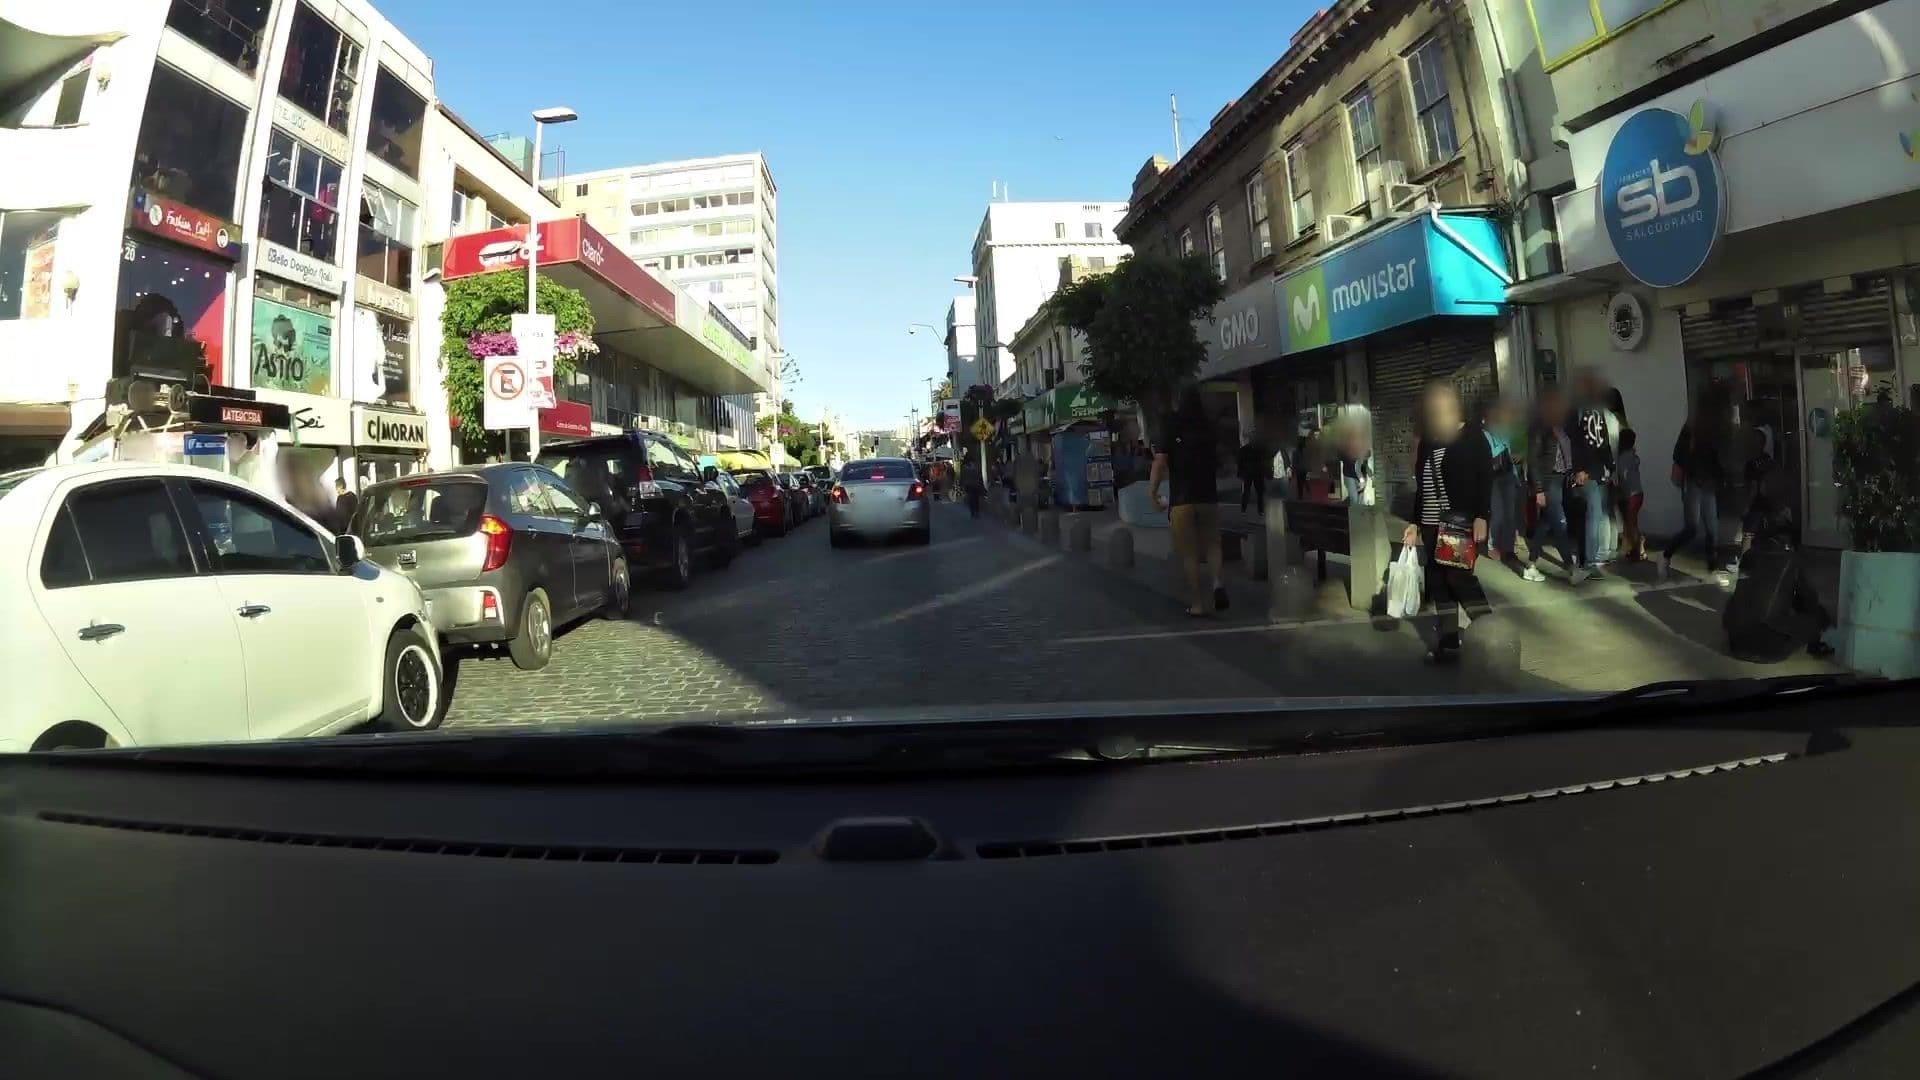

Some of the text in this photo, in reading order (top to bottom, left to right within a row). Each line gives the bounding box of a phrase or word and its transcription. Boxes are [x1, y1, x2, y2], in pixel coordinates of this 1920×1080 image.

[1617, 159, 1699, 229] sb
[124, 246, 136, 261] 20
[1332, 257, 1417, 314] movistar
[1220, 307, 1259, 350] GMO
